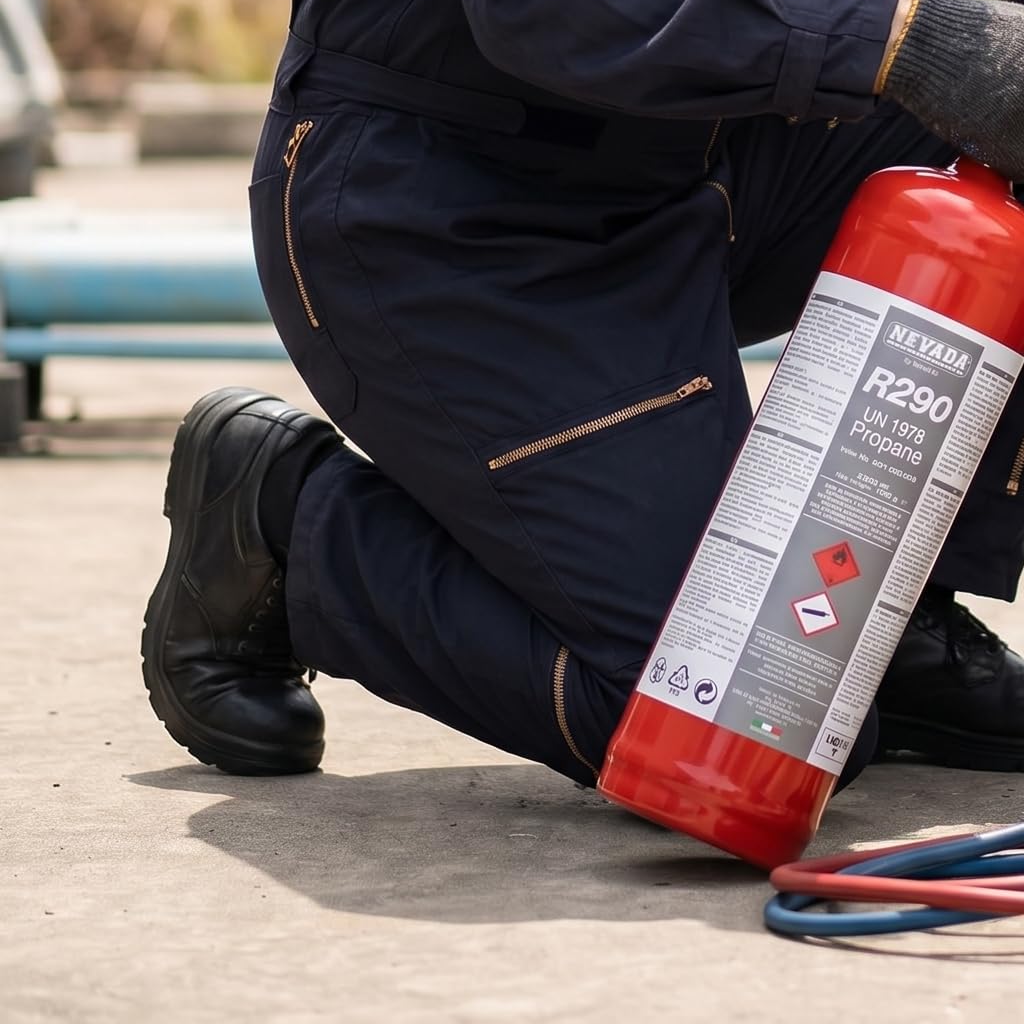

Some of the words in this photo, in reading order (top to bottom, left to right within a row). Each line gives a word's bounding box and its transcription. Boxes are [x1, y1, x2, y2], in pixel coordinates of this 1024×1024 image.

[889, 325, 969, 371] NEVADA
[862, 366, 953, 423] R290
[849, 419, 923, 465] Propane
[863, 406, 889, 428] UN
[892, 418, 926, 445] 1978
